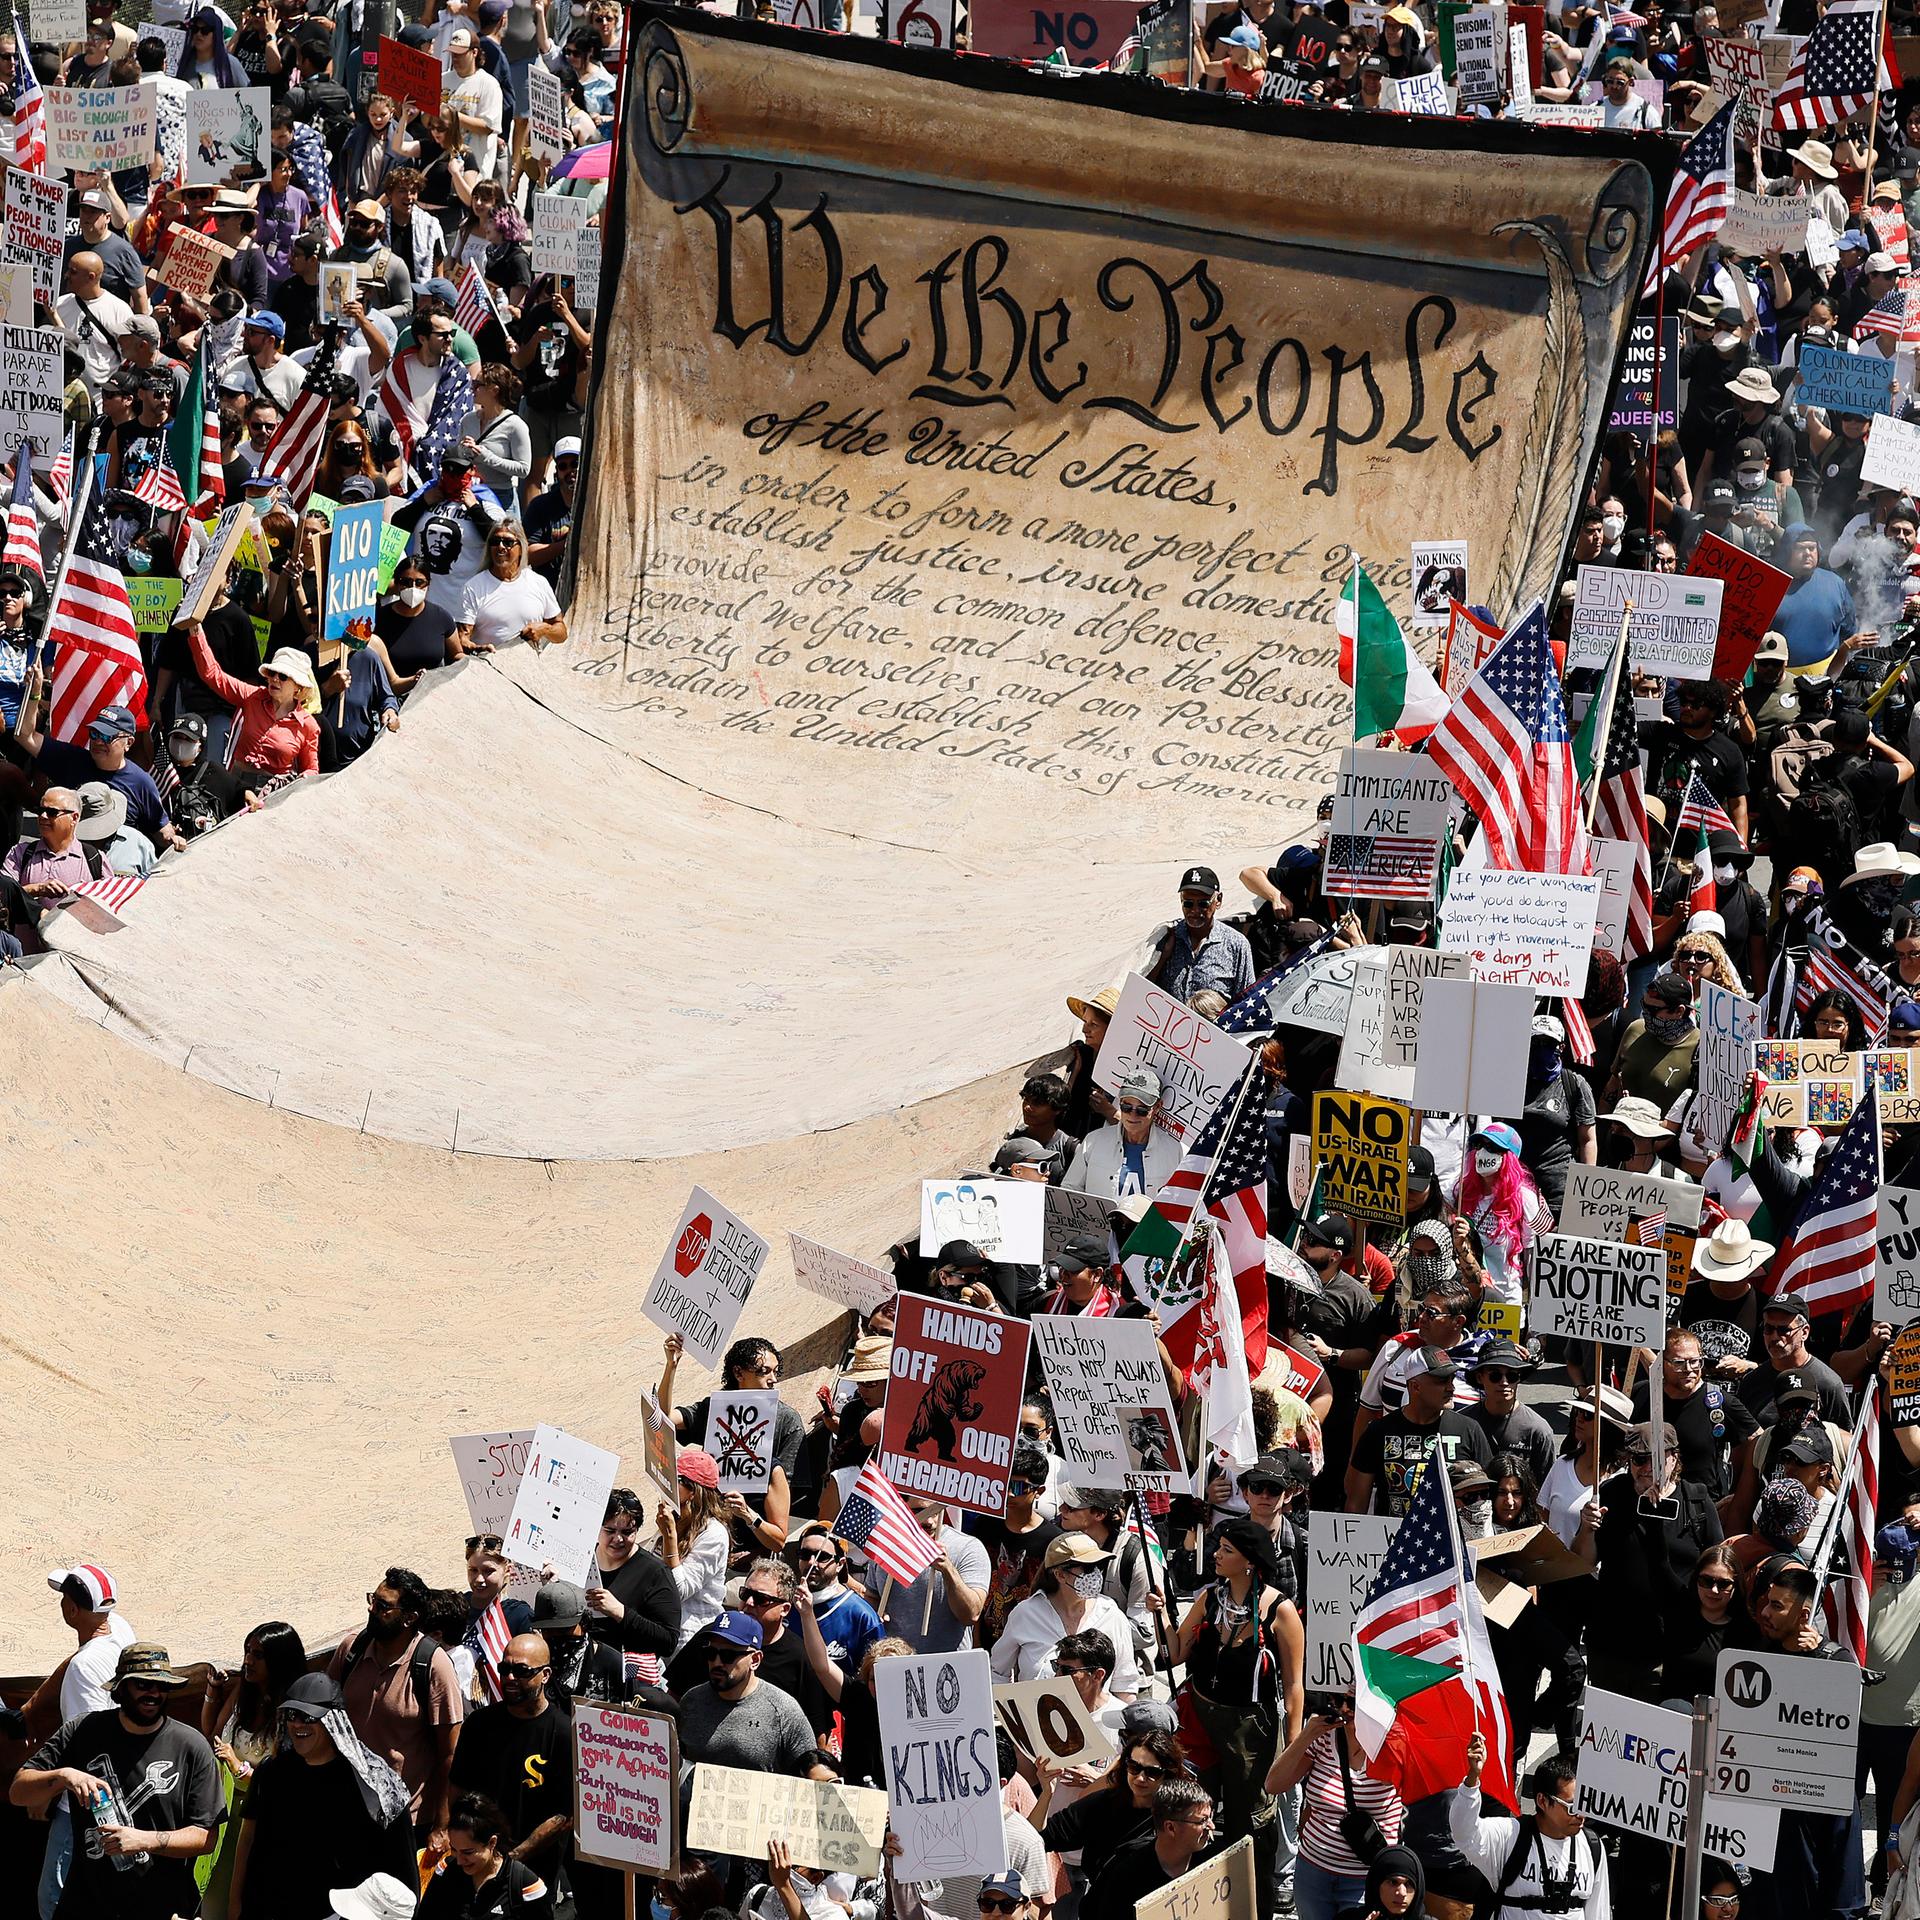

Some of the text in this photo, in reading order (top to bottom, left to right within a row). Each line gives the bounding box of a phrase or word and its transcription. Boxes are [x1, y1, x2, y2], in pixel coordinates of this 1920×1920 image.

[1033, 10, 1097, 49] NO
[1455, 20, 1492, 34] NEWSOM:
[1297, 34, 1326, 62] NO
[1456, 36, 1492, 51] SEND THE
[1704, 35, 1765, 80] RESPECT
[1282, 60, 1298, 74] THE
[1458, 59, 1492, 75] NATIONAL
[1465, 72, 1486, 83] GUARD
[1728, 71, 1749, 85] OUR
[48, 88, 140, 107] NO SIGN IS
[1400, 75, 1441, 99] FUCK
[54, 107, 147, 125] BIG ENOUGH TO
[1528, 106, 1563, 115] FEDERAL
[58, 123, 147, 142] LIST ALL THE
[532, 119, 558, 139] LOSE
[533, 130, 559, 149] THEM
[8, 172, 64, 204] THE POWER
[20, 193, 56, 216] OF THE
[572, 202, 580, 216] A
[6, 205, 56, 233] PEOPLE IS
[539, 217, 576, 231] CLOWN
[8, 223, 62, 258] STRONGER
[534, 236, 572, 250] GET A
[6, 244, 54, 270] THAN THE
[168, 247, 213, 272] HAPPENED
[4, 327, 62, 355] MILITARY
[673, 164, 1502, 497] We the People
[1631, 325, 1654, 341] NO
[4, 352, 52, 373] PARADE
[1802, 348, 1890, 379] COLONIZERS
[8, 372, 47, 389] FOR A
[16, 412, 28, 431] IS
[743, 402, 1237, 513] of the United States,
[338, 519, 372, 564] NO
[669, 500, 843, 552] establish
[839, 534, 1014, 582] justice,
[1018, 559, 1169, 602] insure
[1416, 554, 1462, 567] NO KINGS
[1702, 542, 1764, 589] HOW DO
[145, 581, 164, 590] THE
[1580, 569, 1669, 609] END
[146, 594, 166, 607] BOY
[1661, 615, 1718, 645] UNITED
[600, 615, 1347, 758] Liberty to ourselves and our Posterity
[1340, 773, 1450, 803] IMMIGANTS
[1364, 809, 1410, 834] ARE
[1333, 852, 1424, 879] AMERICA
[1456, 872, 1472, 885] If
[1479, 874, 1502, 886] you
[1506, 875, 1536, 886] ever
[1519, 896, 1532, 906] do
[1535, 896, 1568, 913] during
[1803, 905, 1847, 950] NO
[1493, 948, 1559, 968] doing it
[1136, 992, 1212, 1059] STOP
[1136, 1031, 1221, 1105] HITTING
[1801, 1051, 1850, 1073] are
[1706, 1068, 1744, 1108] UNDER
[1320, 1097, 1404, 1145] NO
[1318, 1134, 1402, 1163] US-ISRAEL
[1318, 1153, 1400, 1196] WAR
[1573, 1176, 1668, 1205] NORMAL
[1580, 1200, 1636, 1216] PEOPLE
[676, 1225, 710, 1264] STOP
[718, 1220, 762, 1274] ILLEGAL
[1536, 1238, 1662, 1272] WE ARE NOT
[703, 1245, 754, 1306] DETENTION
[1534, 1259, 1661, 1310] RIOTING
[653, 1278, 724, 1352] DEPORTATION
[1563, 1302, 1624, 1322] WE ARE
[921, 1308, 1003, 1354] HANDS
[1554, 1315, 1646, 1343] PATRIOTS
[1041, 1322, 1106, 1366] History
[892, 1346, 938, 1383] OFF
[1045, 1356, 1161, 1383] Does NOT ALWAYS
[1052, 1378, 1150, 1404] Repeat Itself
[727, 1405, 758, 1426] NO
[1059, 1416, 1120, 1436] It Often
[961, 1428, 1011, 1467] OUR
[1068, 1438, 1118, 1475] Rhymes.
[880, 1452, 1005, 1509] NEIGHBORS
[1123, 1473, 1171, 1491] RESIST!
[1333, 1518, 1361, 1544] IF
[1312, 1600, 1341, 1616] WE
[904, 1662, 961, 1720] NO
[600, 1710, 650, 1737] GOING
[1778, 1702, 1850, 1730] Metro
[579, 1723, 668, 1765] Backwards
[1580, 1722, 1689, 1779] AMERICA
[1720, 1735, 1736, 1760] 4
[1777, 1746, 1817, 1757] Santa Monica
[891, 1728, 992, 1807] KINGS
[1718, 1766, 1750, 1794] 90
[1793, 1781, 1825, 1790] Hollywood
[583, 1792, 663, 1828] Still is not
[1578, 1784, 1659, 1833] HUMAN
[597, 1813, 658, 1845] ENOUGH
